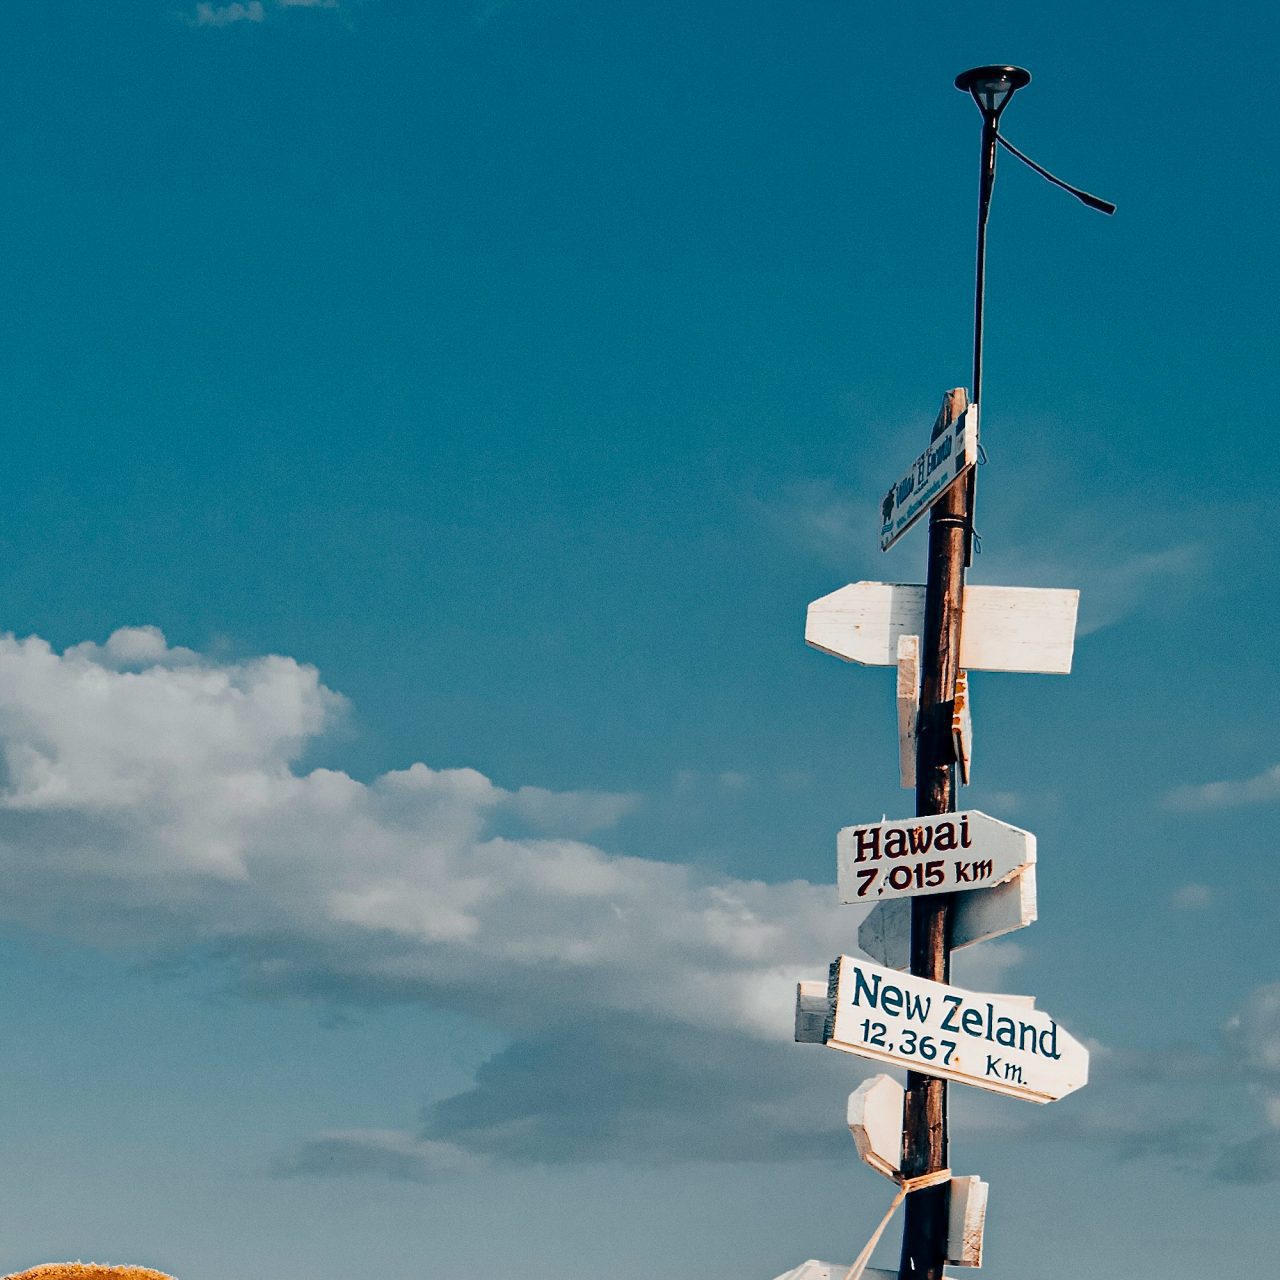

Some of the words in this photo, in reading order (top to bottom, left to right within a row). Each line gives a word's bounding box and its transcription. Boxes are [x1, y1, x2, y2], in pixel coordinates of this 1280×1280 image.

[853, 815, 972, 863] Hawai
[857, 860, 945, 897] 7,015
[852, 967, 931, 1023] New
[941, 995, 1062, 1060] Zeland
[860, 1018, 957, 1066] 12,367
